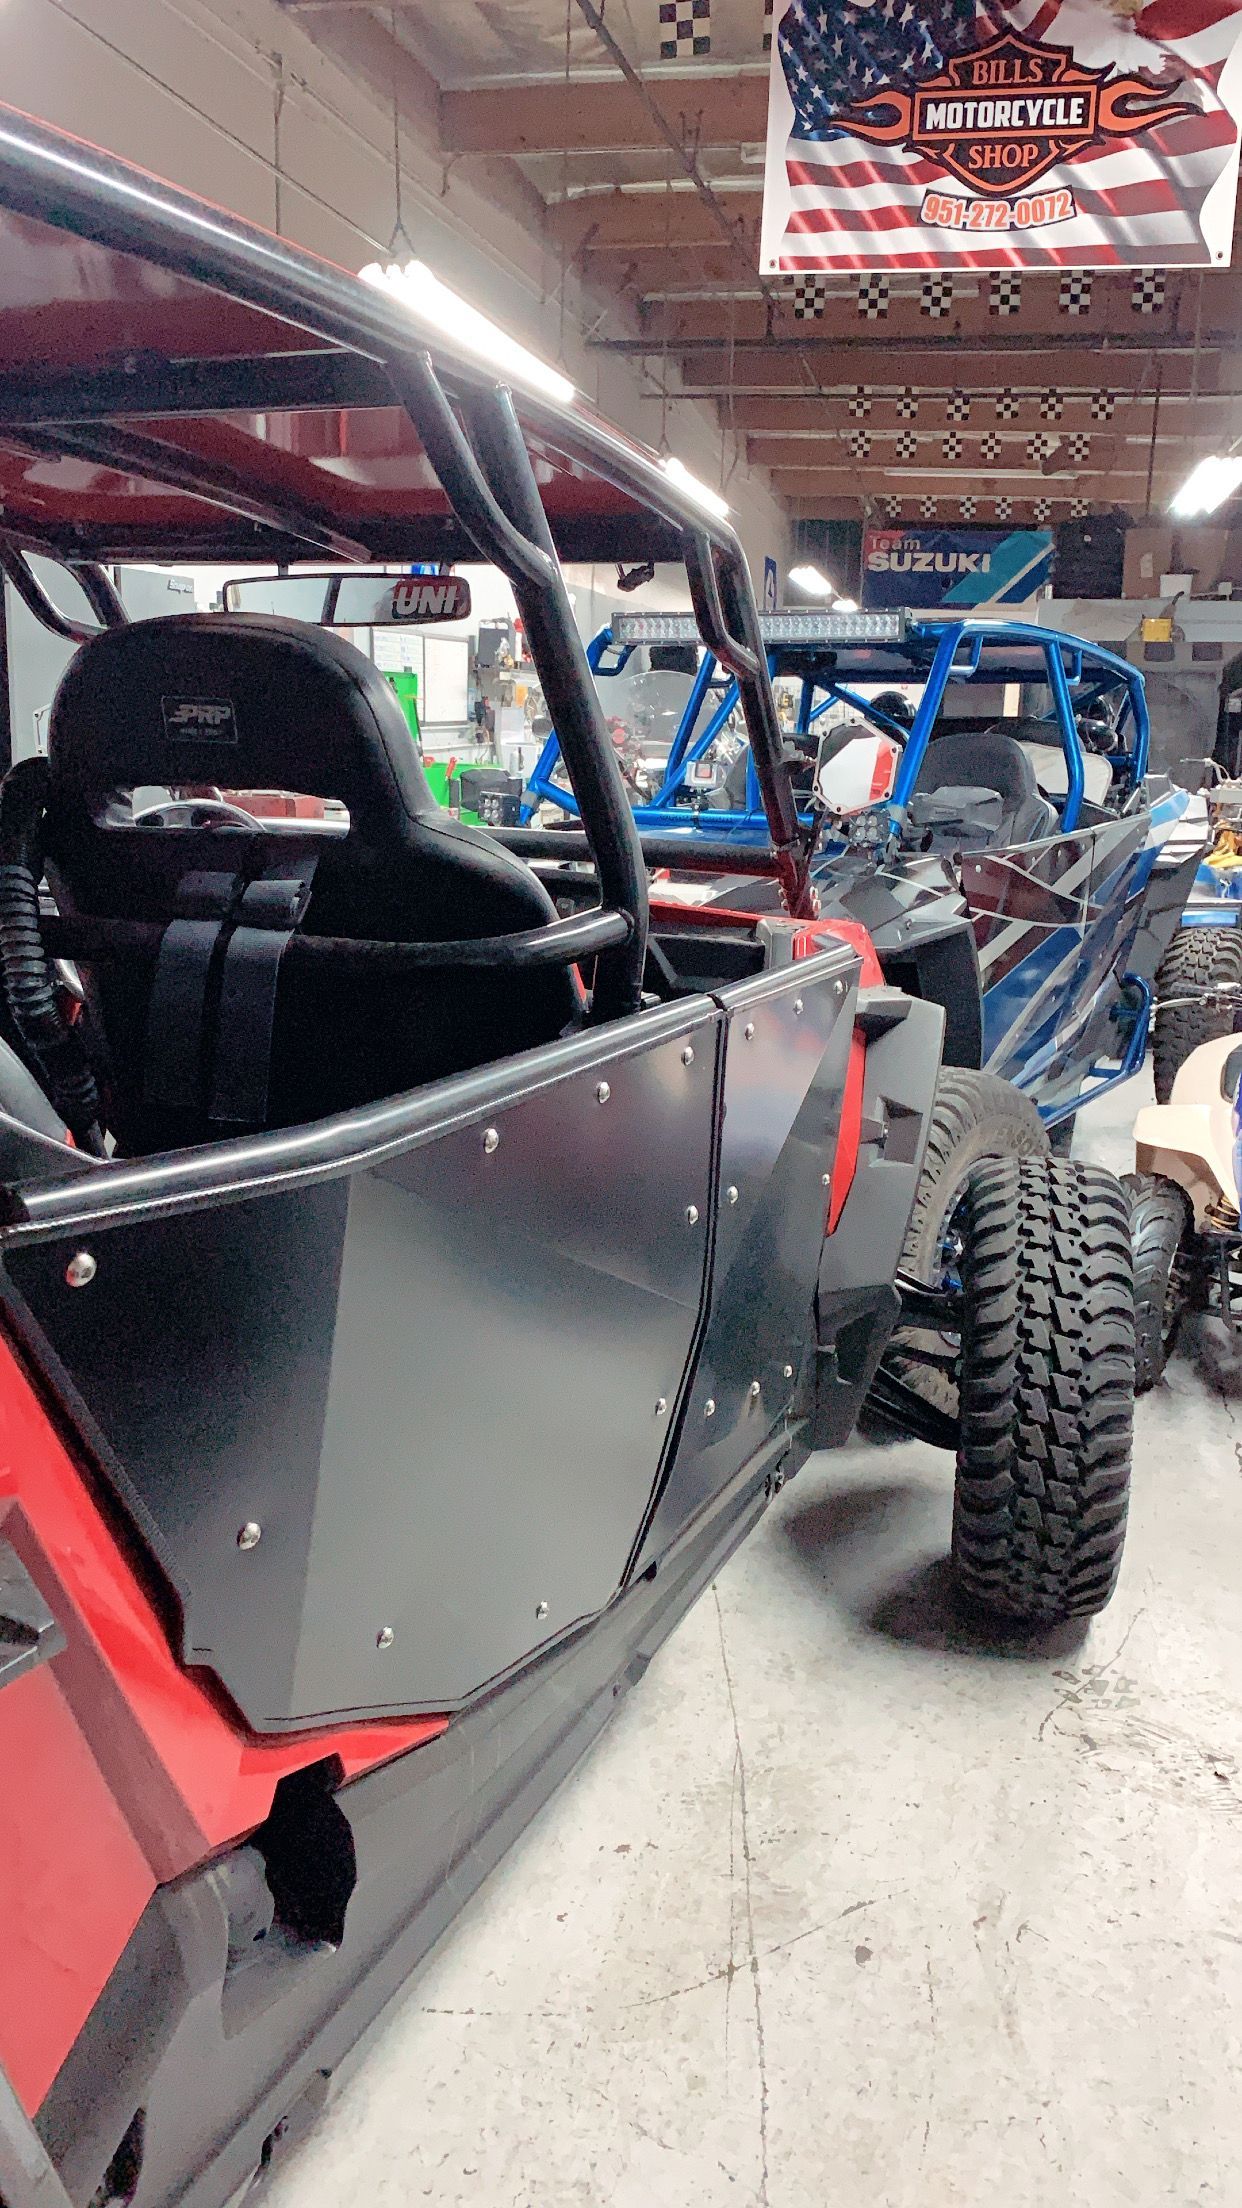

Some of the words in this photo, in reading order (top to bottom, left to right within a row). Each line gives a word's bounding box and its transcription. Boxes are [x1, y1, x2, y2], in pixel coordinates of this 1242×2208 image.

[972, 58, 1043, 85] BILLS
[926, 98, 1084, 130] MOTORCYCLE
[968, 144, 1039, 169] SHOP
[923, 190, 1073, 229] 951-272-0072
[870, 536, 920, 550] Team
[867, 551, 991, 572] SUZUKI
[396, 585, 458, 615] UNI
